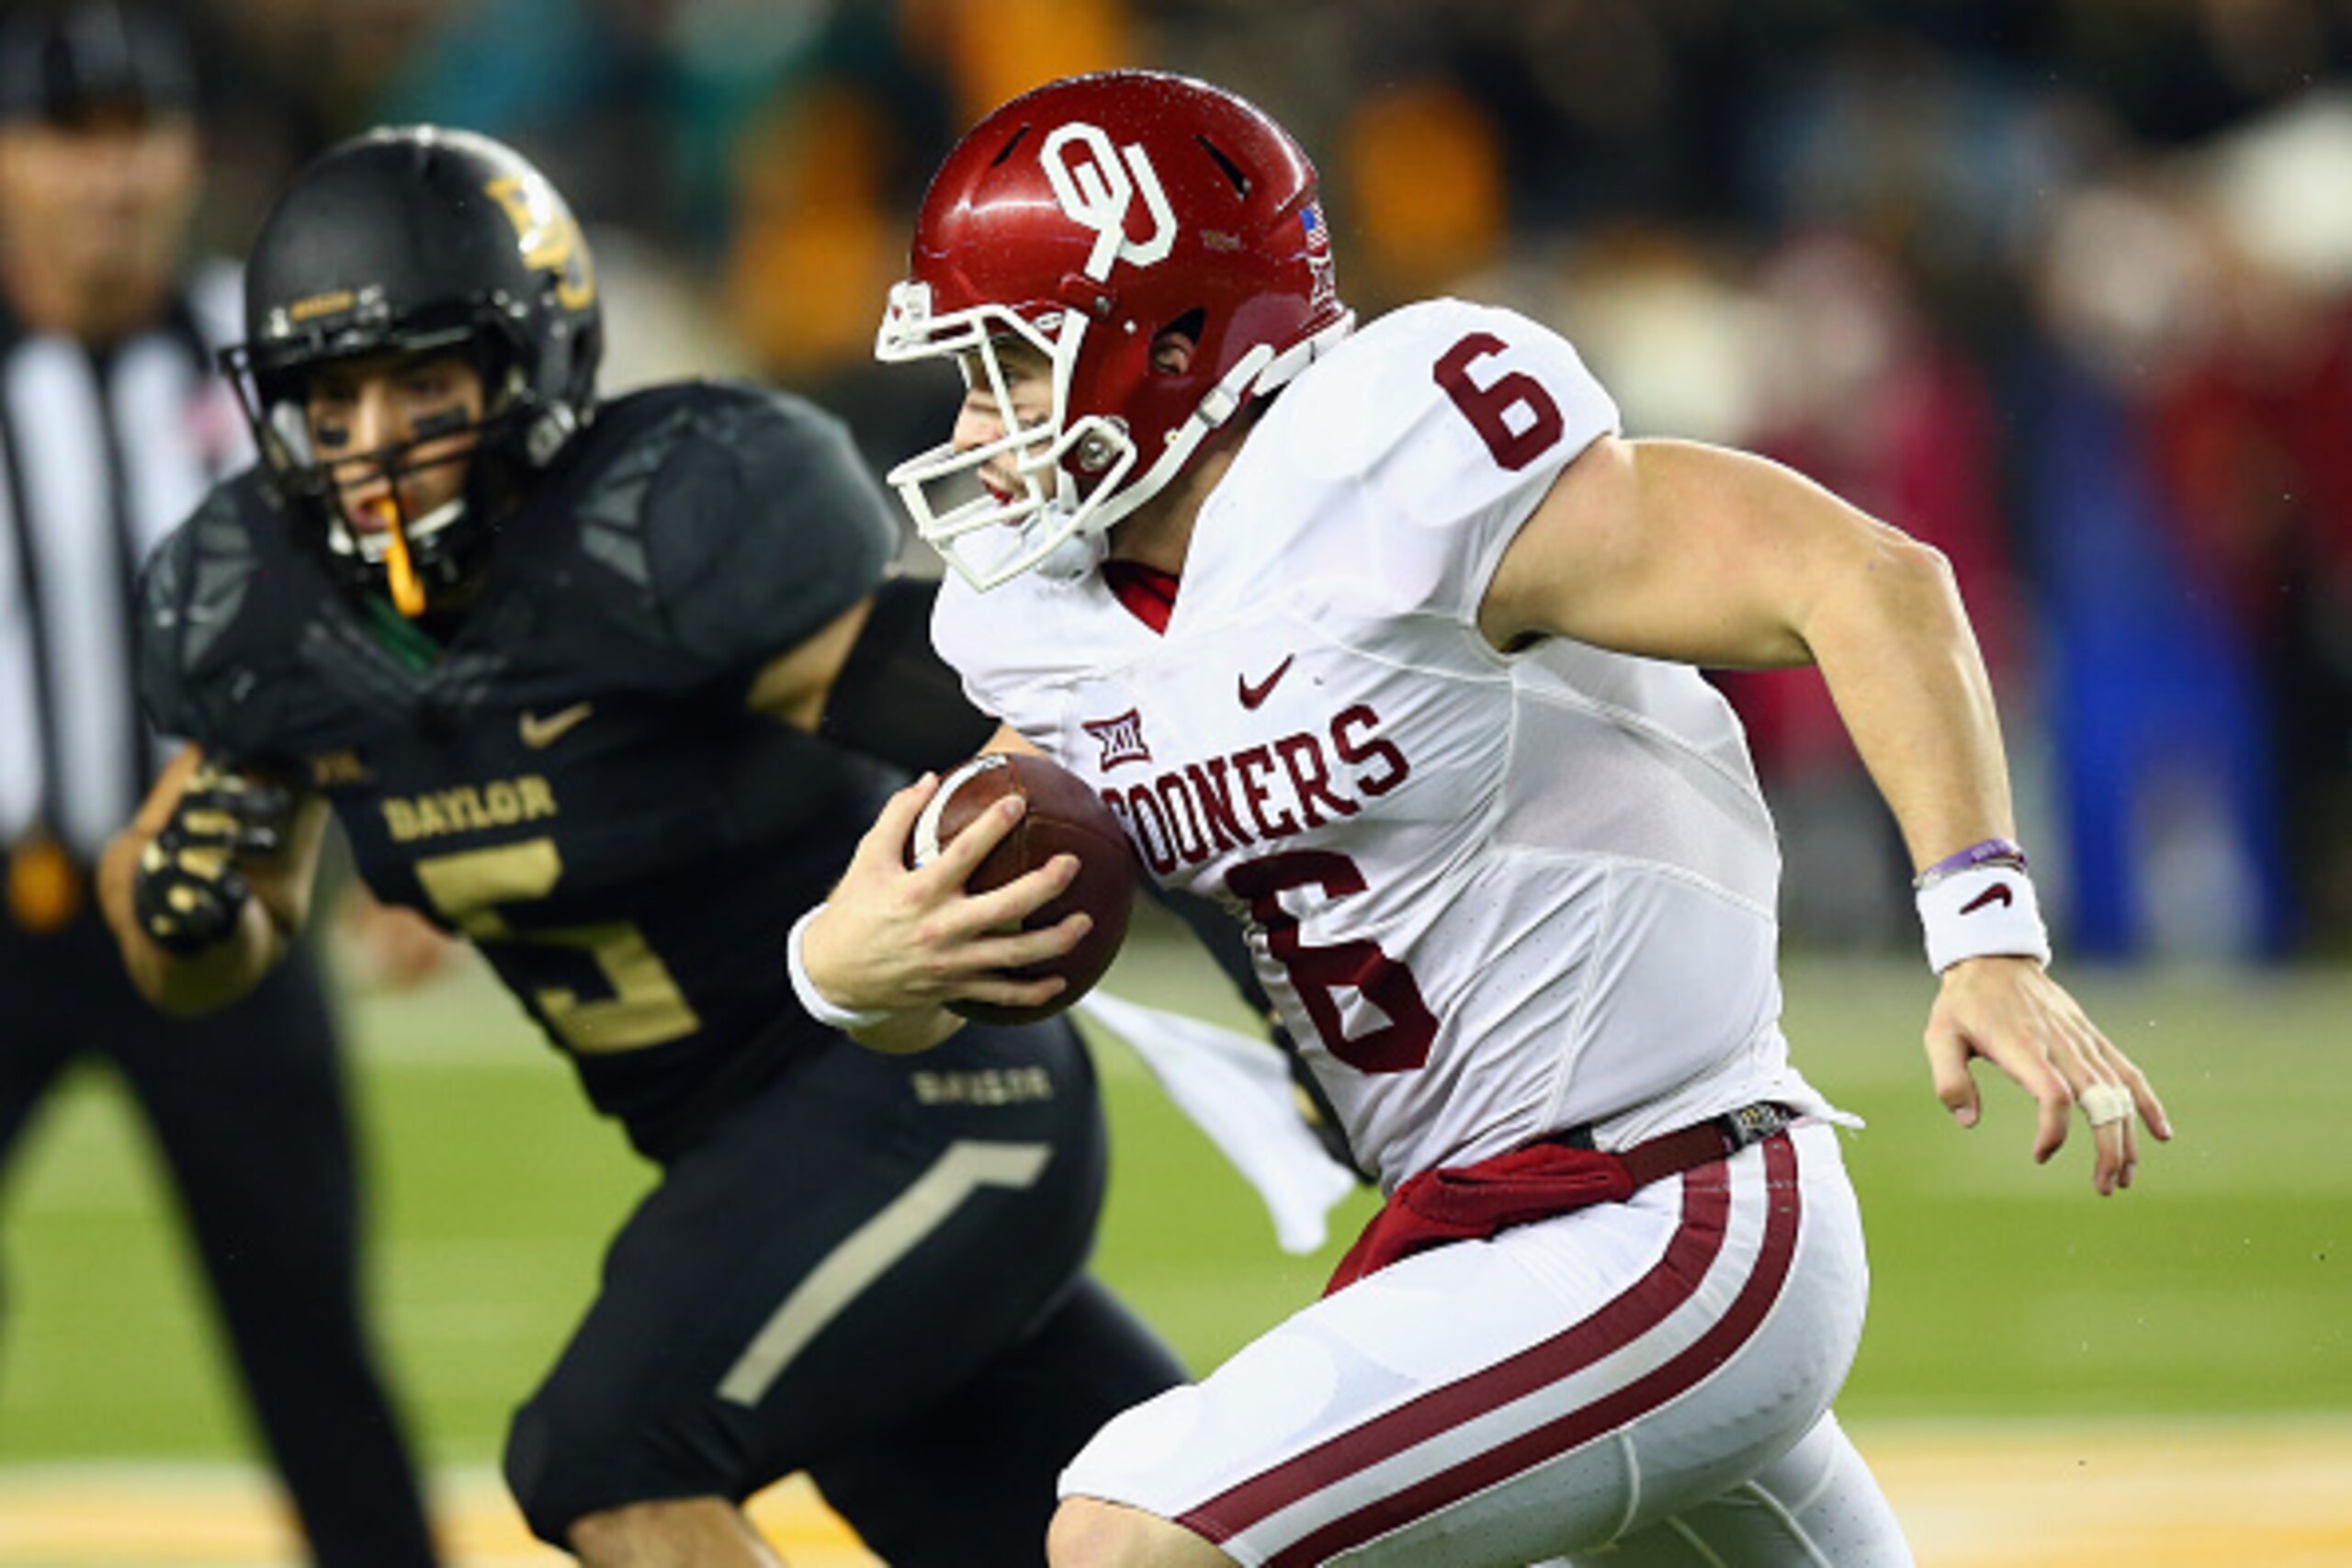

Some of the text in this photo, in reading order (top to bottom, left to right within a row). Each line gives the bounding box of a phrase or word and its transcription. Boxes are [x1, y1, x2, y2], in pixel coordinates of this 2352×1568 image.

[1039, 120, 1178, 283] OU
[1433, 333, 1564, 471] 6
[381, 775, 559, 841] BAYLOR
[414, 838, 702, 1053] 5
[1224, 849, 1439, 1074] 6
